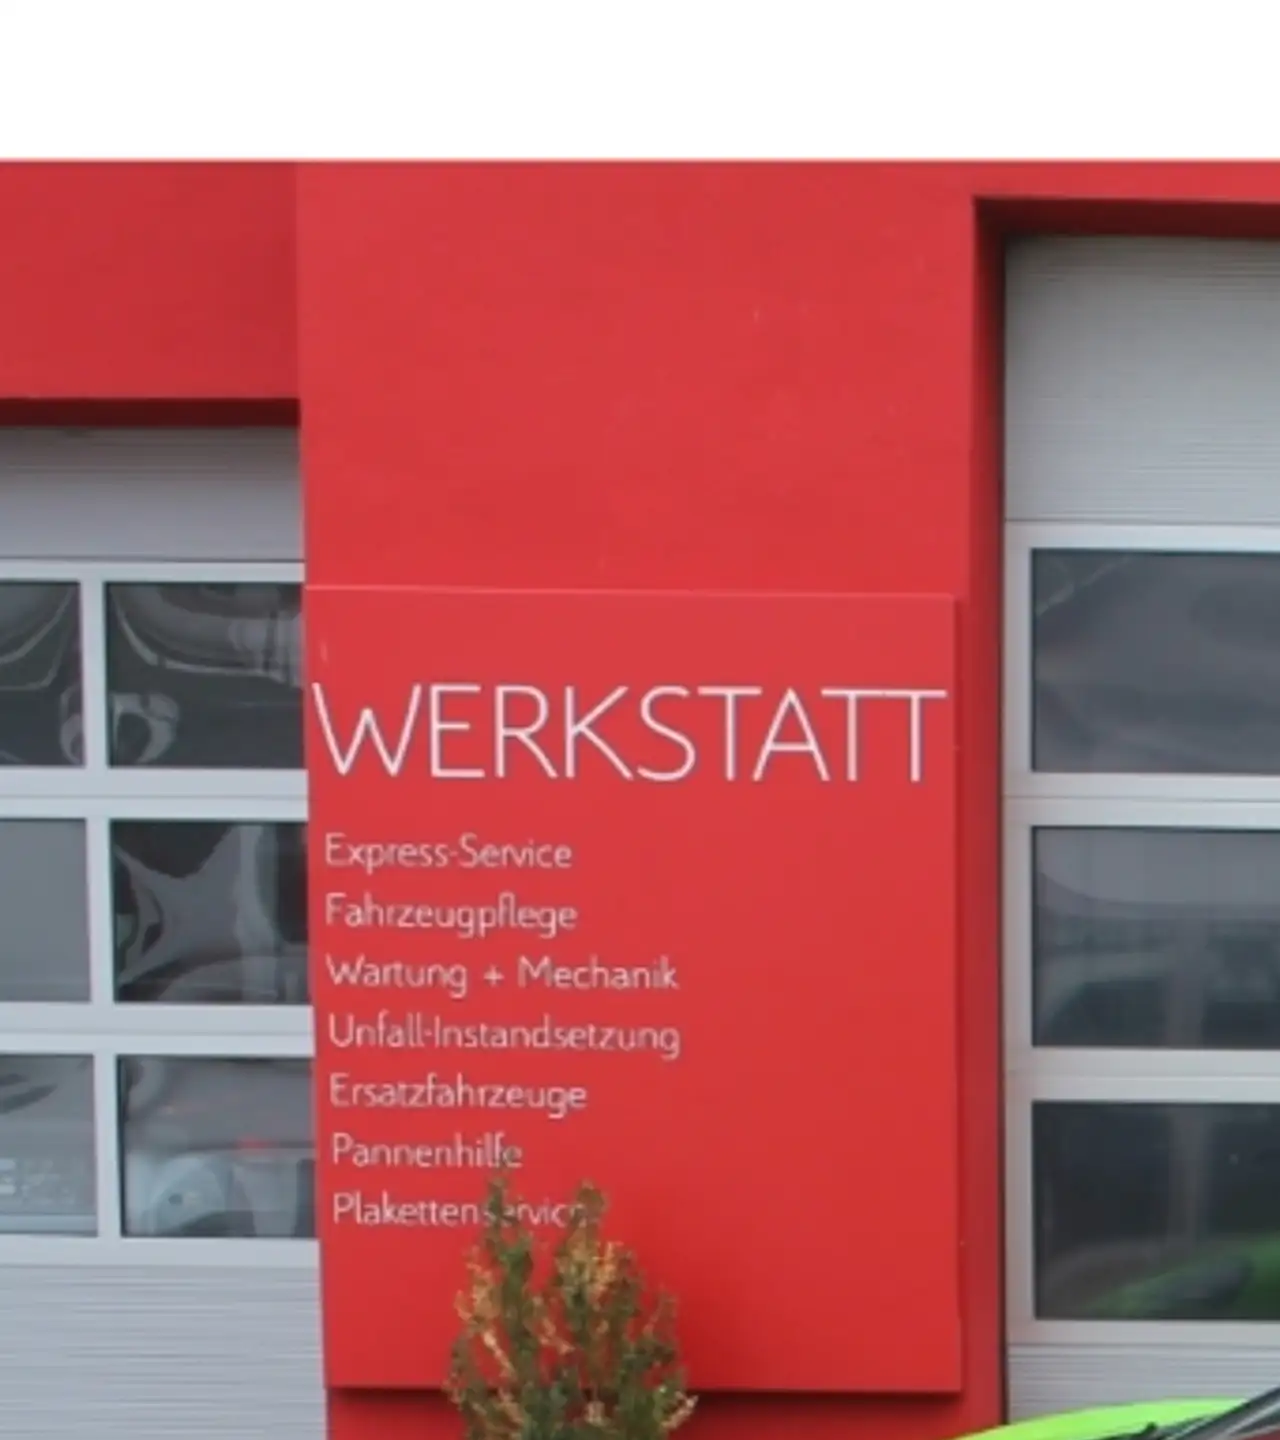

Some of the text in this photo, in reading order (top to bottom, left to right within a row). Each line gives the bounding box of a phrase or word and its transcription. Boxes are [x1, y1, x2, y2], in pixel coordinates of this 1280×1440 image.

[311, 682, 948, 783] WERKSTATT
[325, 832, 573, 875] Express-Service
[325, 891, 578, 939] Fahrzeugpflege
[325, 953, 679, 999] Wartung + Mechanik
[328, 1009, 681, 1060] Unfall-Instandsetzung
[329, 1072, 588, 1119] Ersatzfahrzeuge
[332, 1131, 523, 1168] Pannenhilfe
